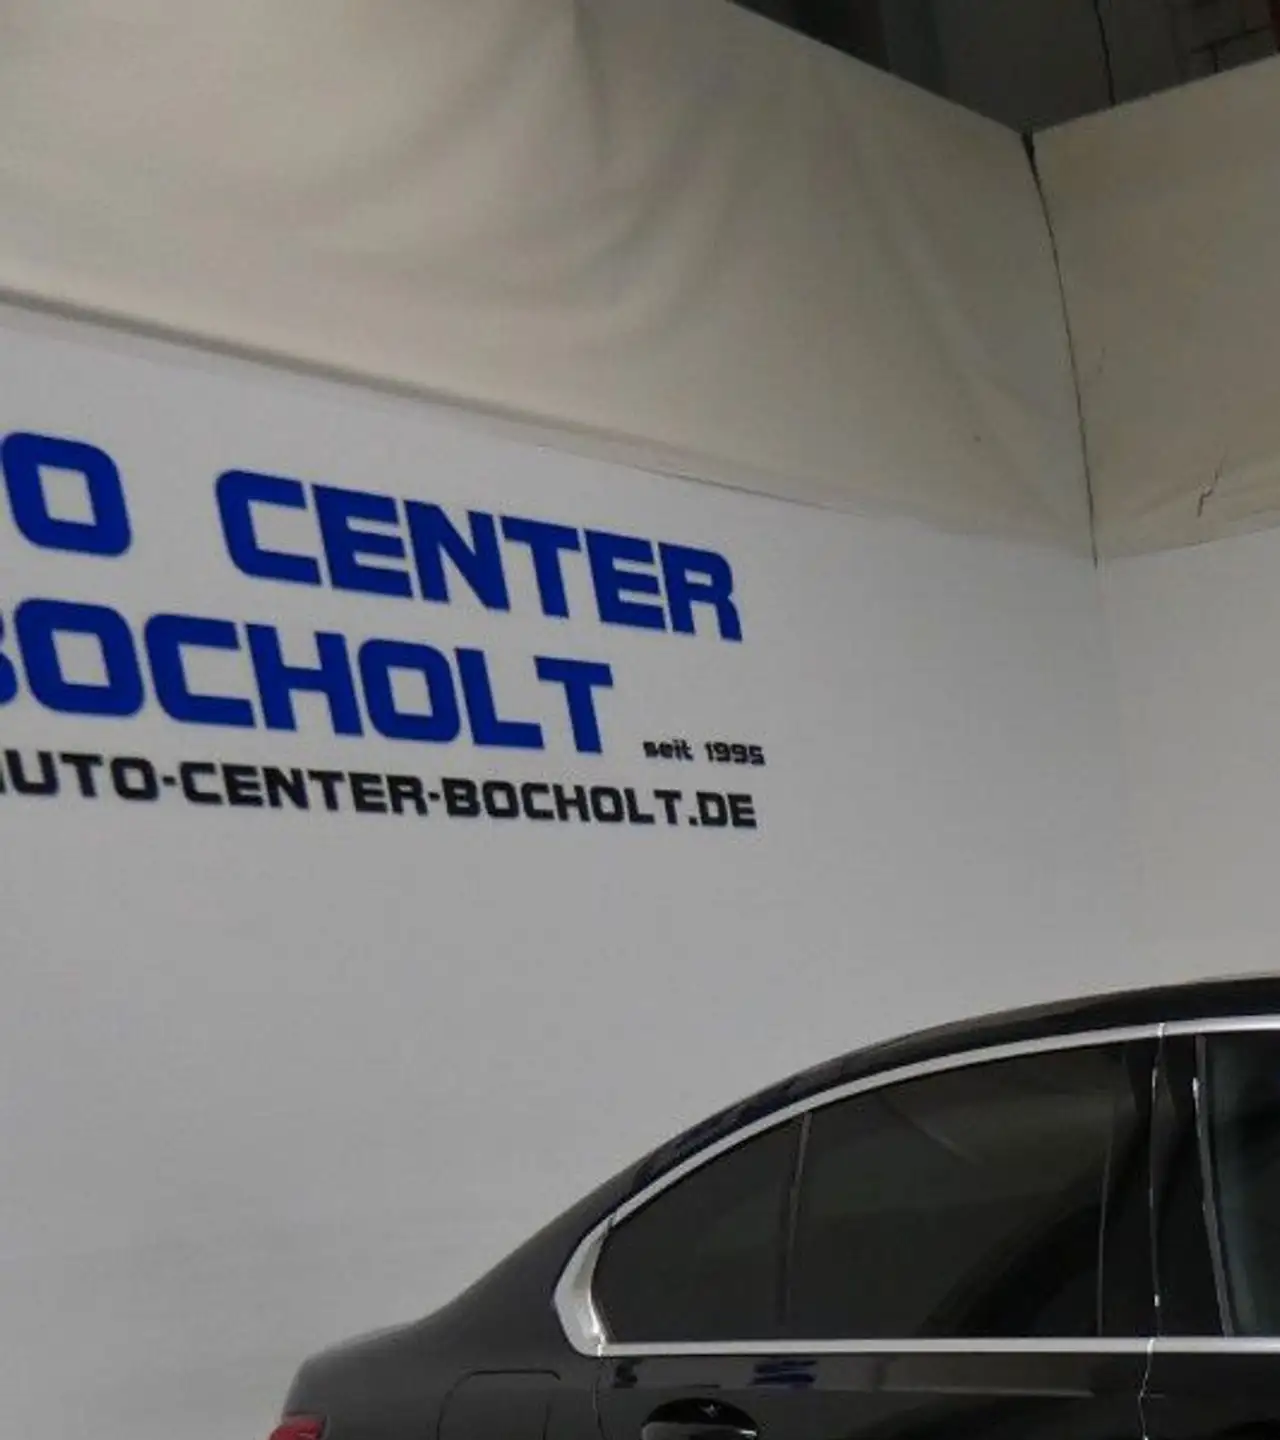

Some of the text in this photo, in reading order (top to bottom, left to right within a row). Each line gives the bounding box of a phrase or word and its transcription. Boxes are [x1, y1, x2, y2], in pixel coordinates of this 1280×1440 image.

[215, 468, 742, 643] CENTER
[0, 597, 615, 757] OCHOLT
[0, 747, 758, 830] UTO-CENTER-BOCHOLT.DE
[642, 738, 767, 767] seit 1995
